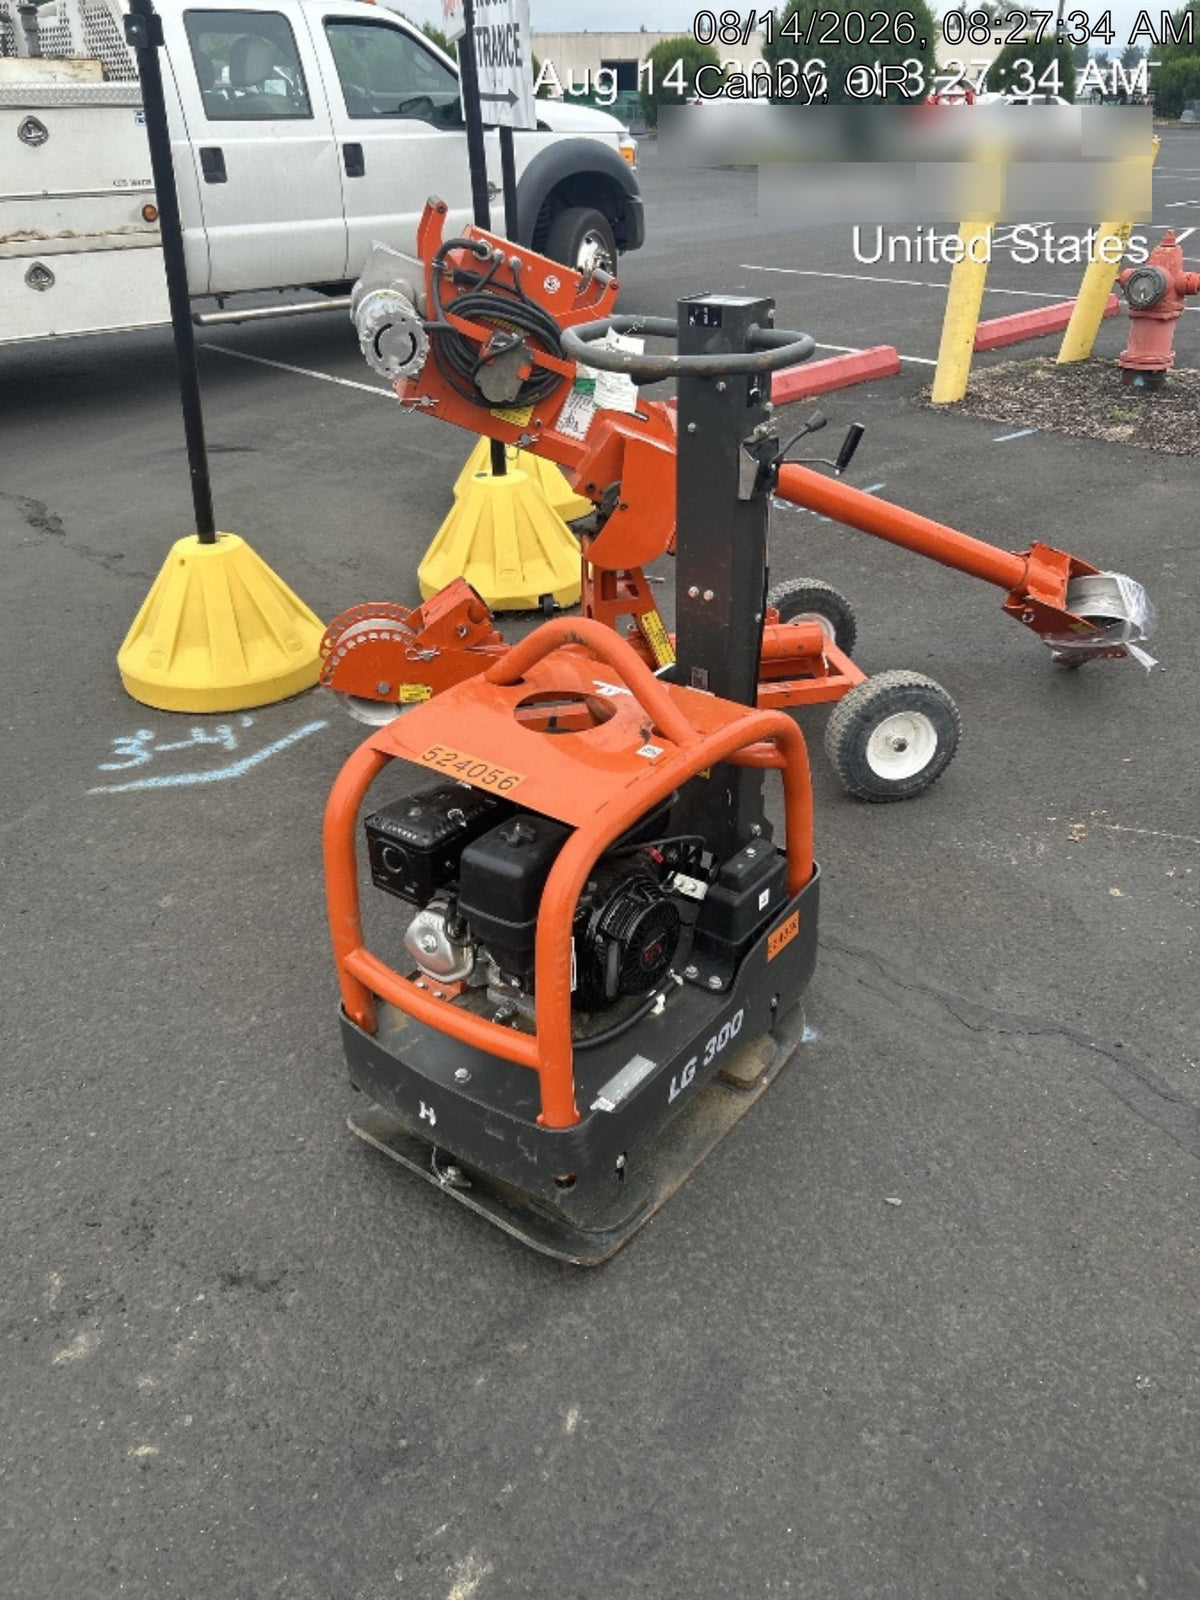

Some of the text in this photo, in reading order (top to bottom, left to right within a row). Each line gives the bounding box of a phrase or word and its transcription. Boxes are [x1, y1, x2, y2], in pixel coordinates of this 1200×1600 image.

[474, 22, 524, 68] TRANCE
[422, 747, 520, 791] 524056
[667, 1007, 744, 1105] LG 300
